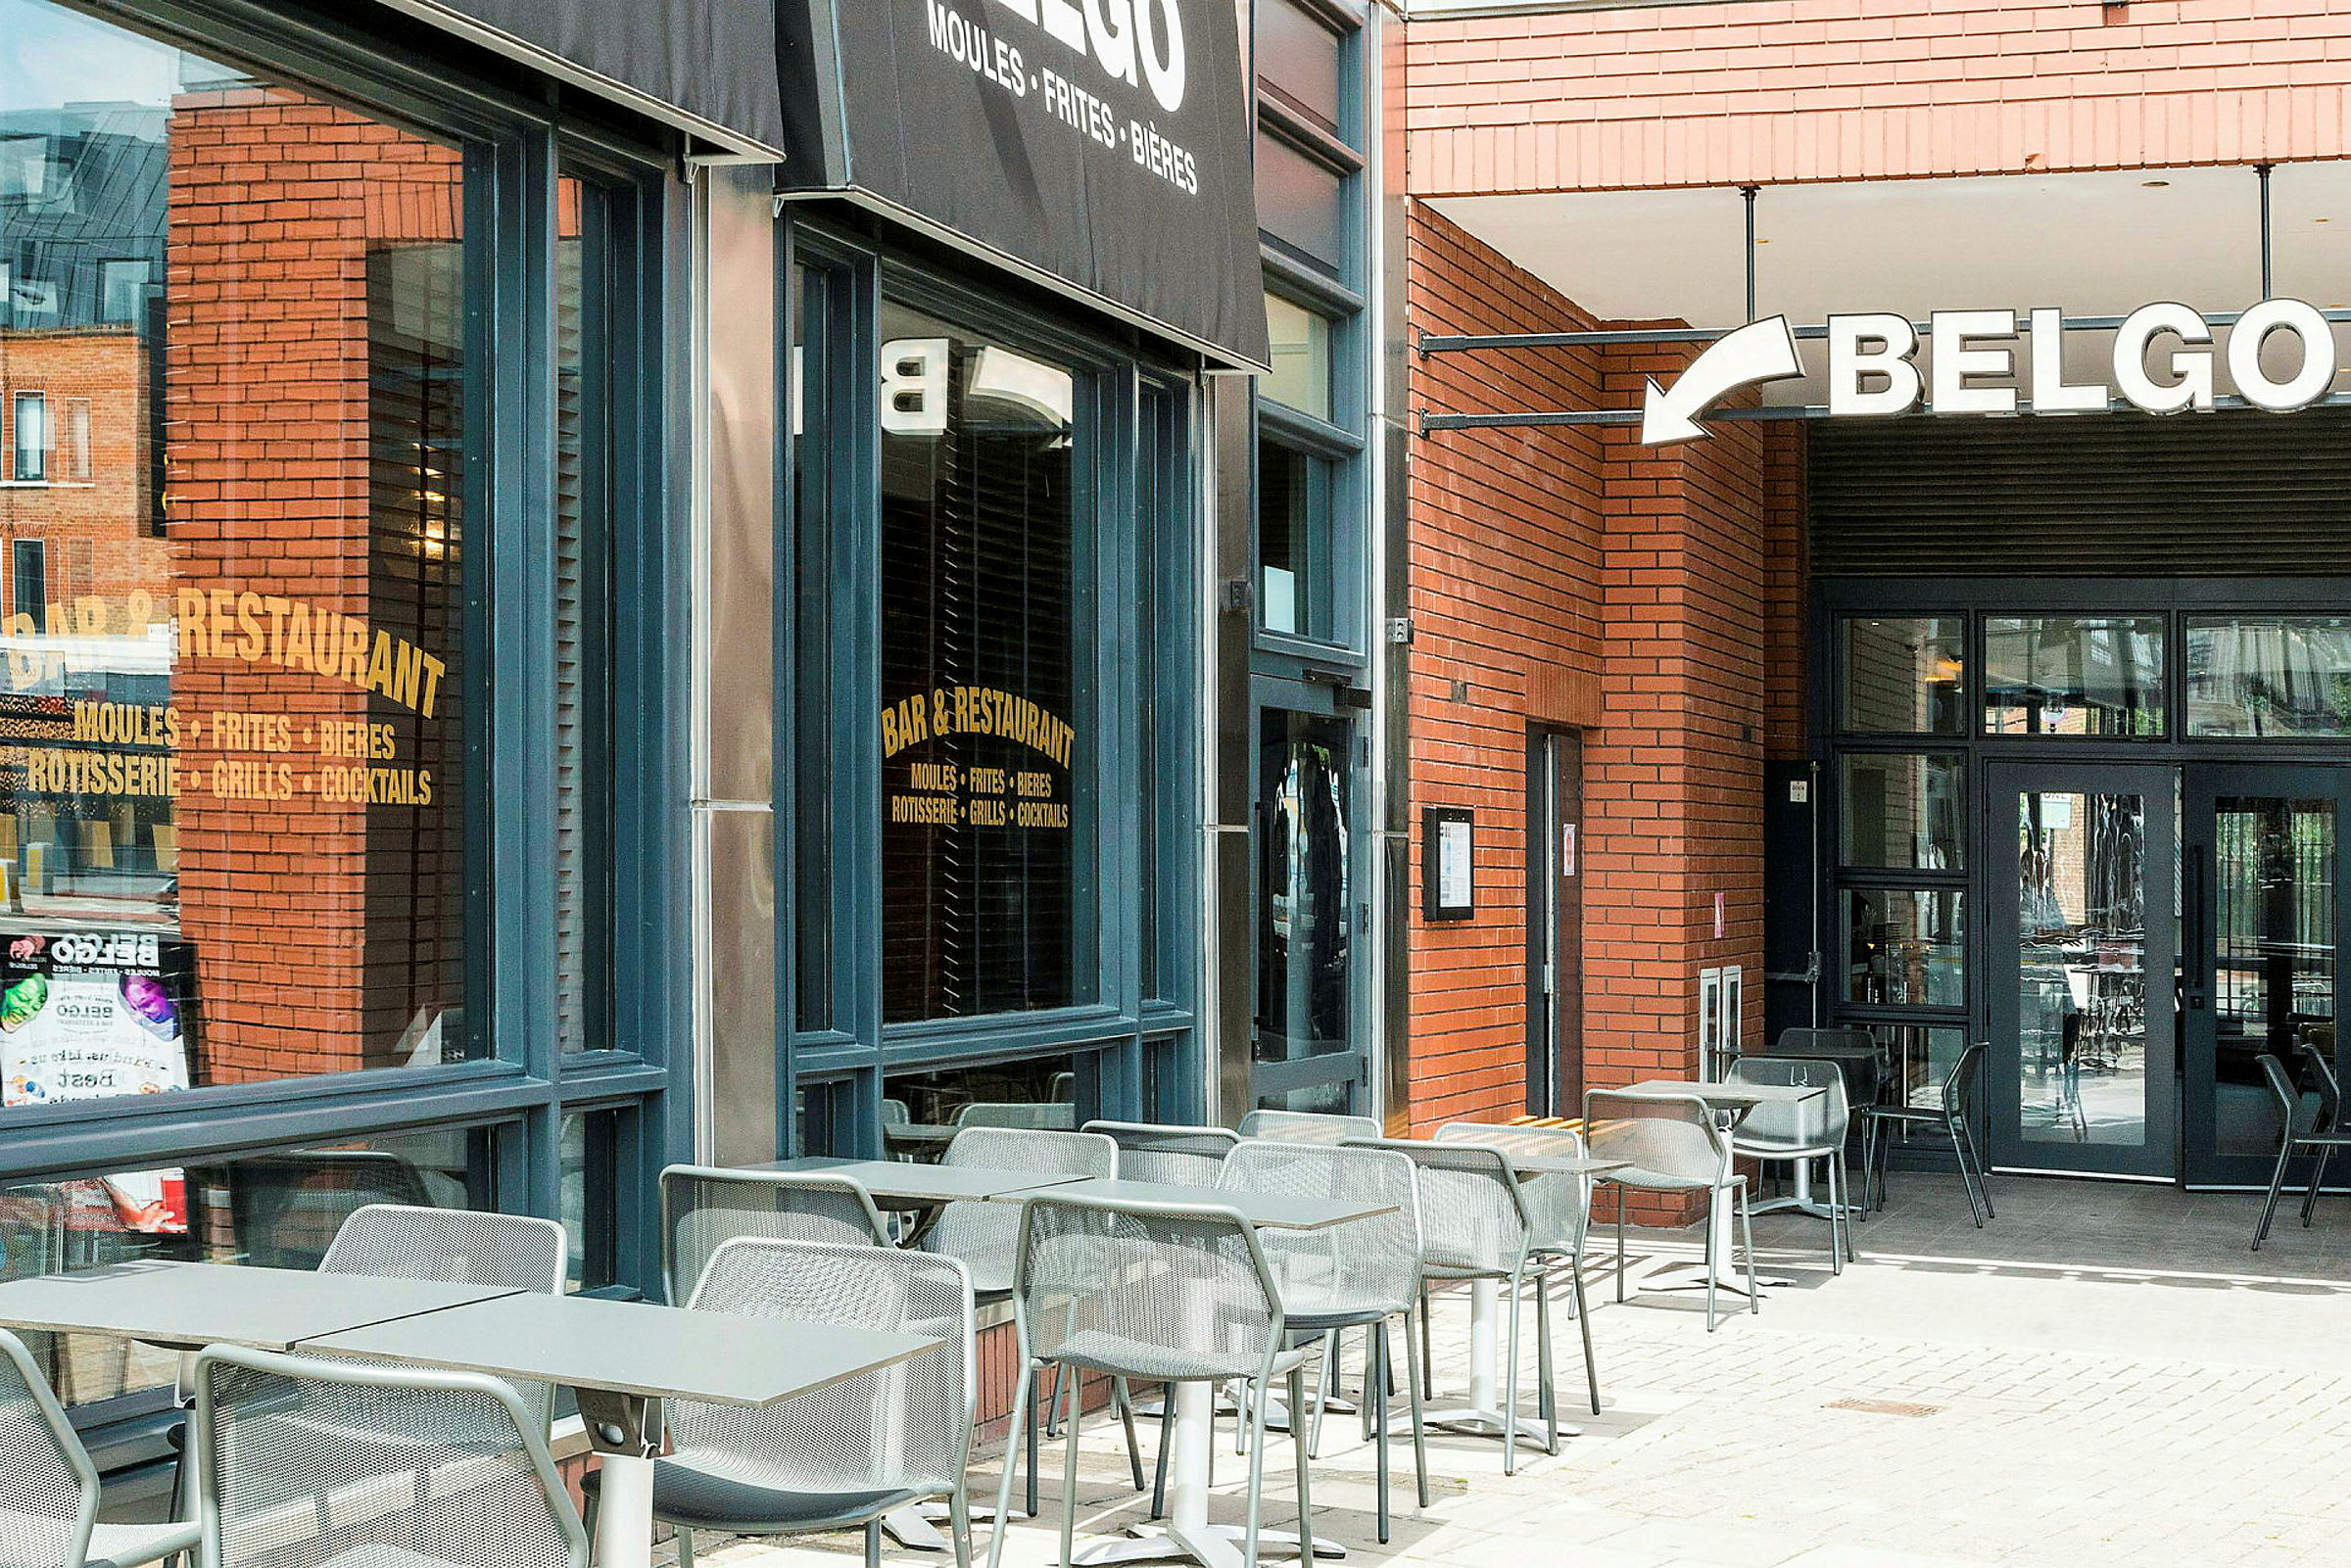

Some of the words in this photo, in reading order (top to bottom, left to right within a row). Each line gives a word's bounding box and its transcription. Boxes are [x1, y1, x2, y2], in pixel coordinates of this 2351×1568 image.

[927, 0, 1026, 97] MOULES
[1042, 68, 1115, 149] FRITES
[1130, 119, 1198, 195] BIÈRES
[1828, 298, 2337, 414] BELGO
[3, 594, 108, 690] BAR
[177, 588, 445, 719] RESTAURANT
[73, 701, 179, 747] MOULES
[212, 712, 291, 752] FRITES
[320, 722, 395, 760] BIERES
[882, 694, 928, 758] BAR
[934, 689, 949, 736] &
[954, 687, 1075, 770] RESTAURANT
[28, 751, 180, 796] ROTISSERIE
[212, 760, 292, 800] GRILLS
[321, 767, 431, 805] COCKTAILS
[892, 795, 957, 824] ROTISSERIE
[970, 799, 1005, 826] GRILLS
[1018, 802, 1068, 828] COCKTAILS
[911, 763, 957, 791] MOULES
[970, 767, 1005, 794] FRITES
[1018, 772, 1051, 797] BIERES
